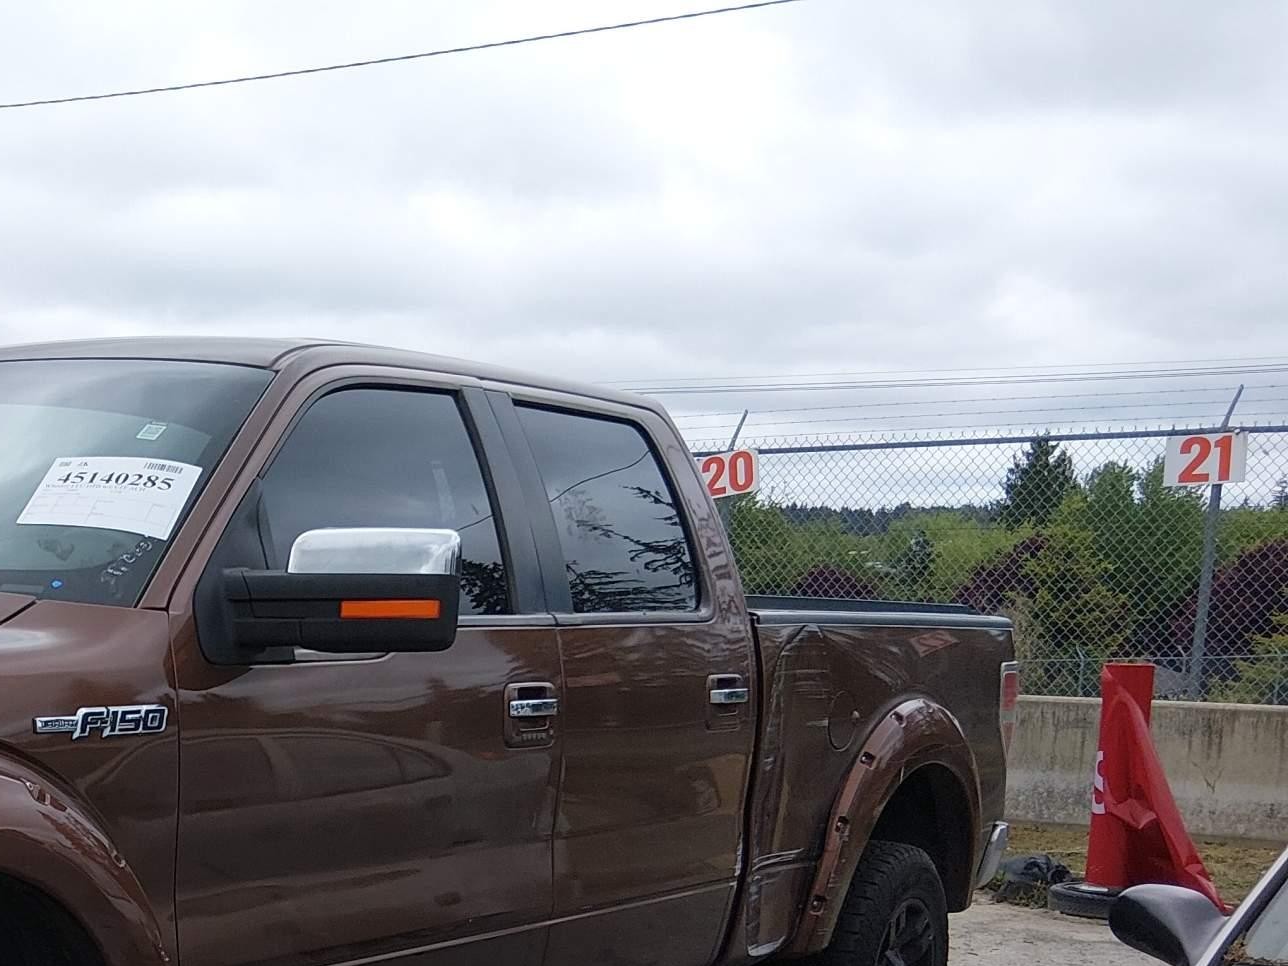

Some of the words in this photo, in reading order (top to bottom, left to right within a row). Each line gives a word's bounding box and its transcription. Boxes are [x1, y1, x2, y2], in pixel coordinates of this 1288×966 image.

[701, 450, 754, 496] 20
[1177, 435, 1233, 483] 21
[56, 470, 176, 491] 45140285
[73, 704, 169, 739] F-150
